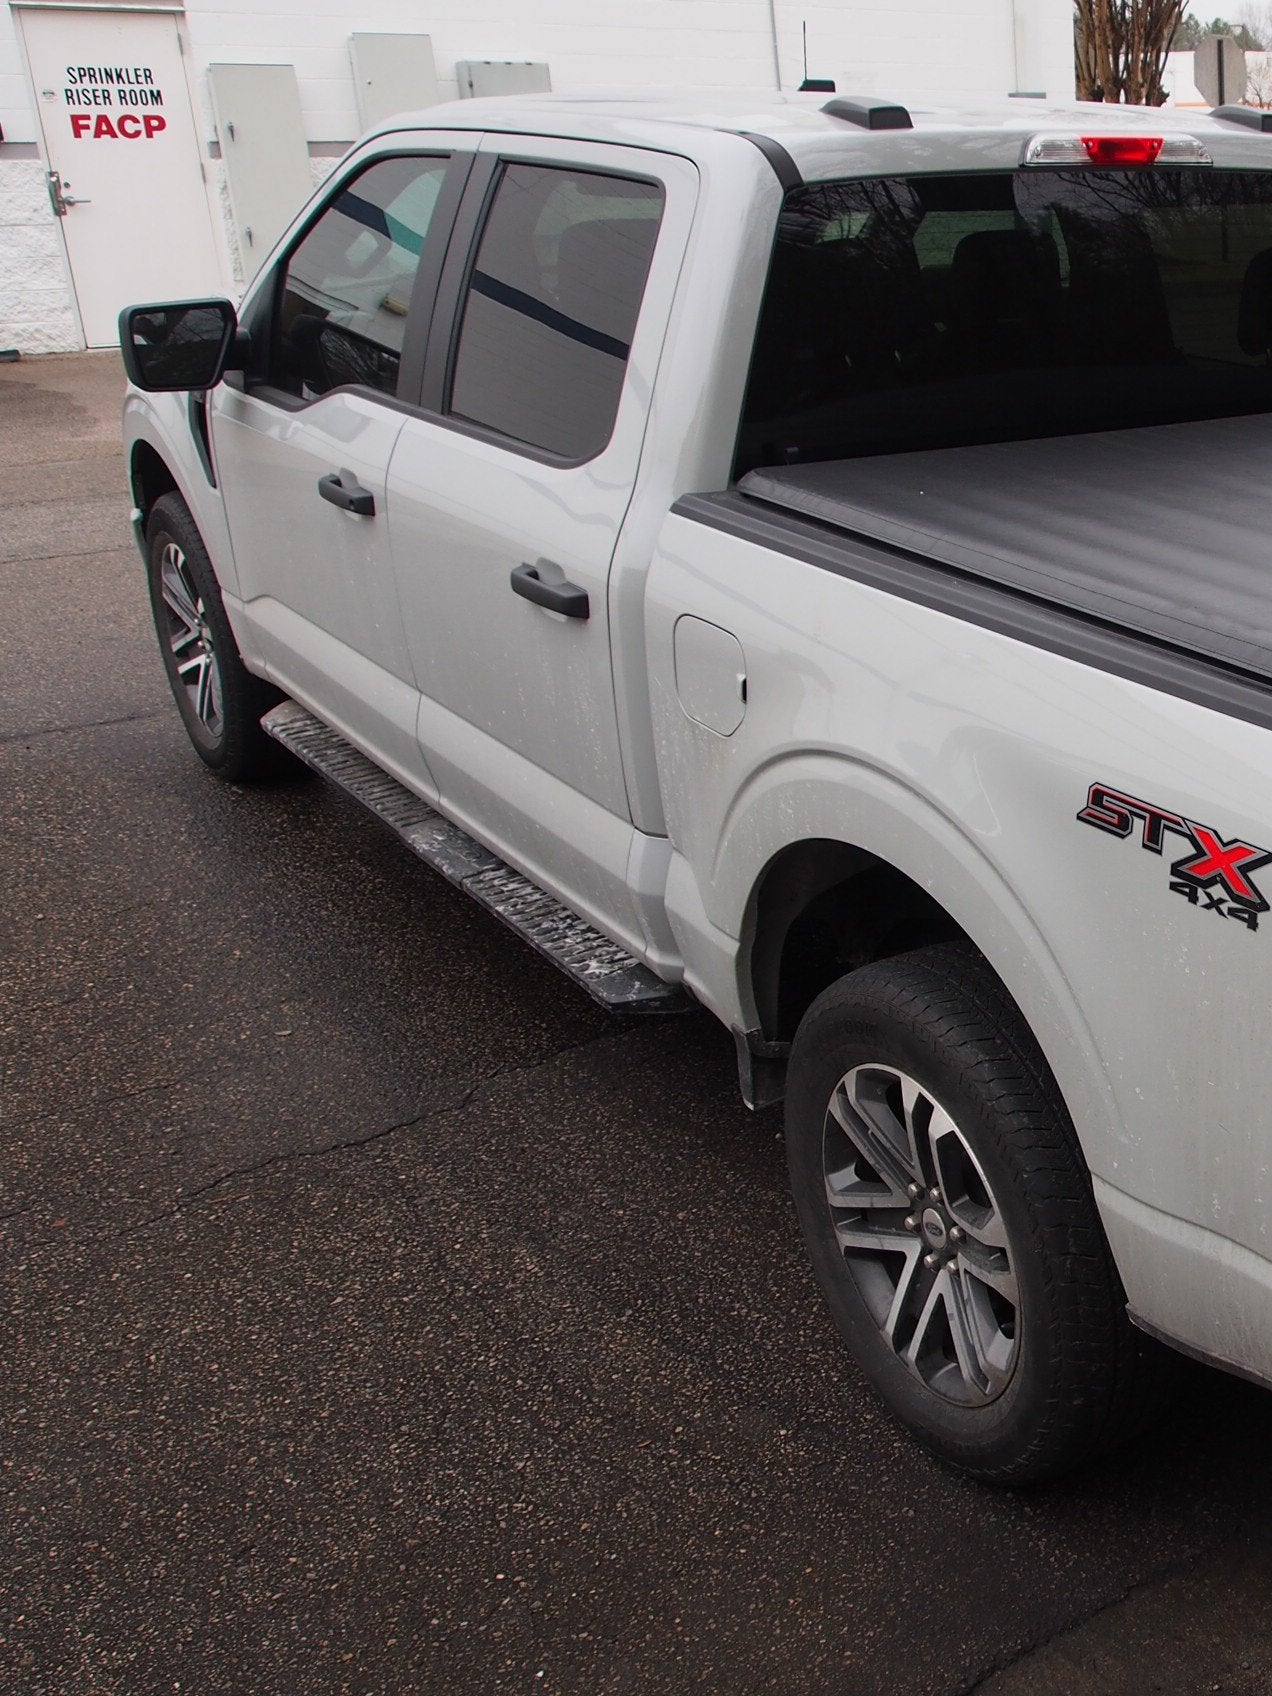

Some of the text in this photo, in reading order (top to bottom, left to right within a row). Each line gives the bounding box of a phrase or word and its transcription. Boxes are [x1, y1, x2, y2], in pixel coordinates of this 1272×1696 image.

[66, 67, 154, 85] SPRINKLER
[64, 88, 113, 106] RISER
[118, 89, 164, 106] ROOM
[70, 114, 167, 139] FACP
